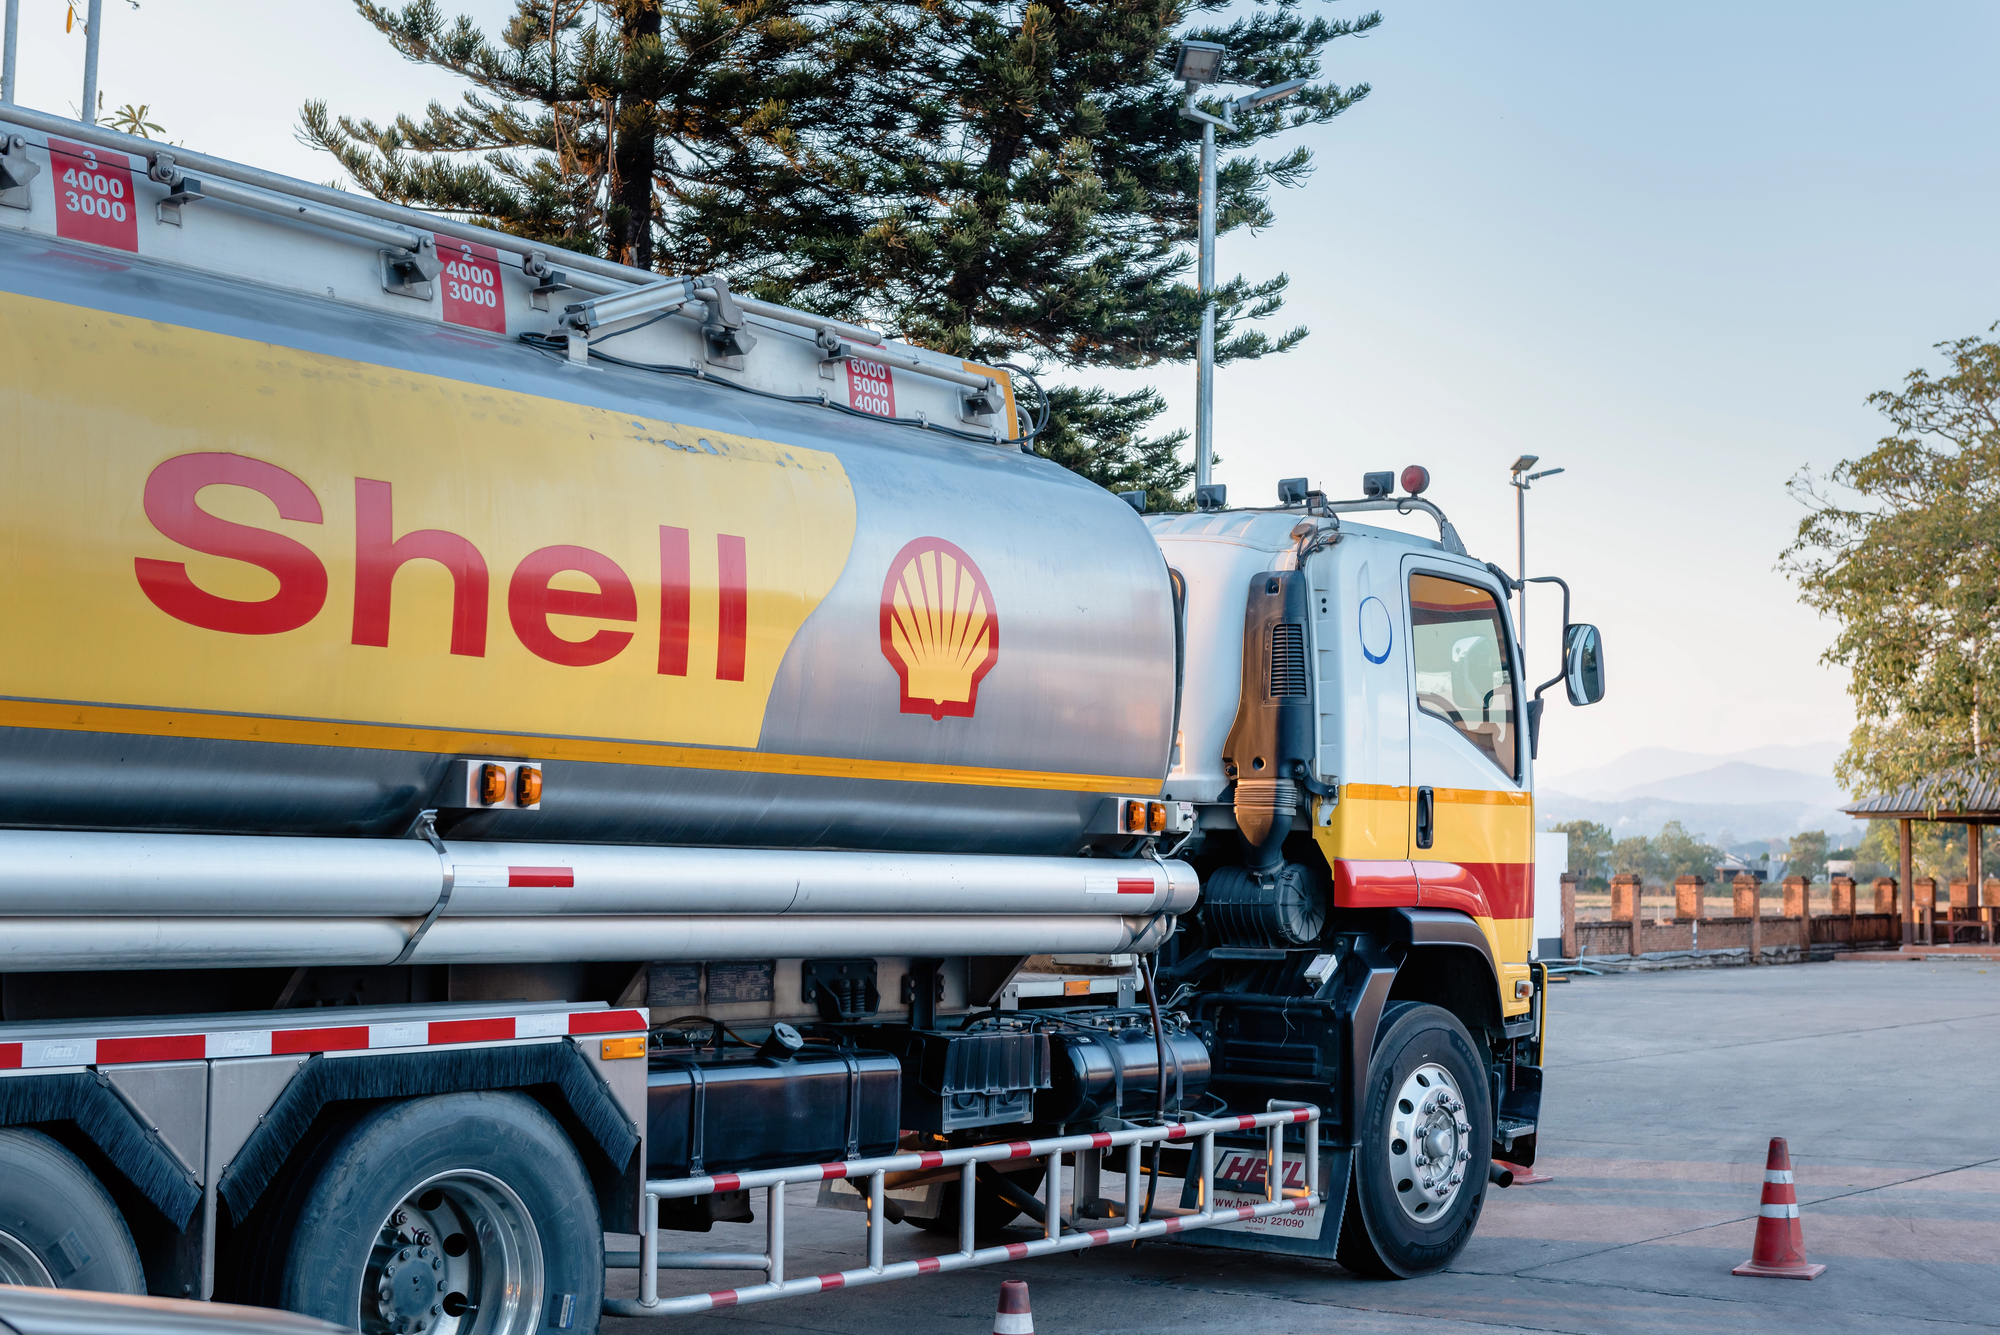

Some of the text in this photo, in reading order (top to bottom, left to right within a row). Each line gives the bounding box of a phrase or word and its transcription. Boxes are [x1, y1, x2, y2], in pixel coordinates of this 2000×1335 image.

[82, 150, 98, 170] 3
[62, 168, 124, 199] 4000
[65, 190, 127, 222] 3000
[460, 244, 475, 263] 2
[446, 260, 495, 287] 4000
[448, 280, 497, 308] 3000
[850, 358, 886, 380] 6000
[853, 375, 889, 398] 5000
[854, 394, 890, 416] 4000
[134, 451, 748, 682] Shell
[45, 1047, 74, 1058] HEIL
[1270, 1216, 1305, 1229] 221090
